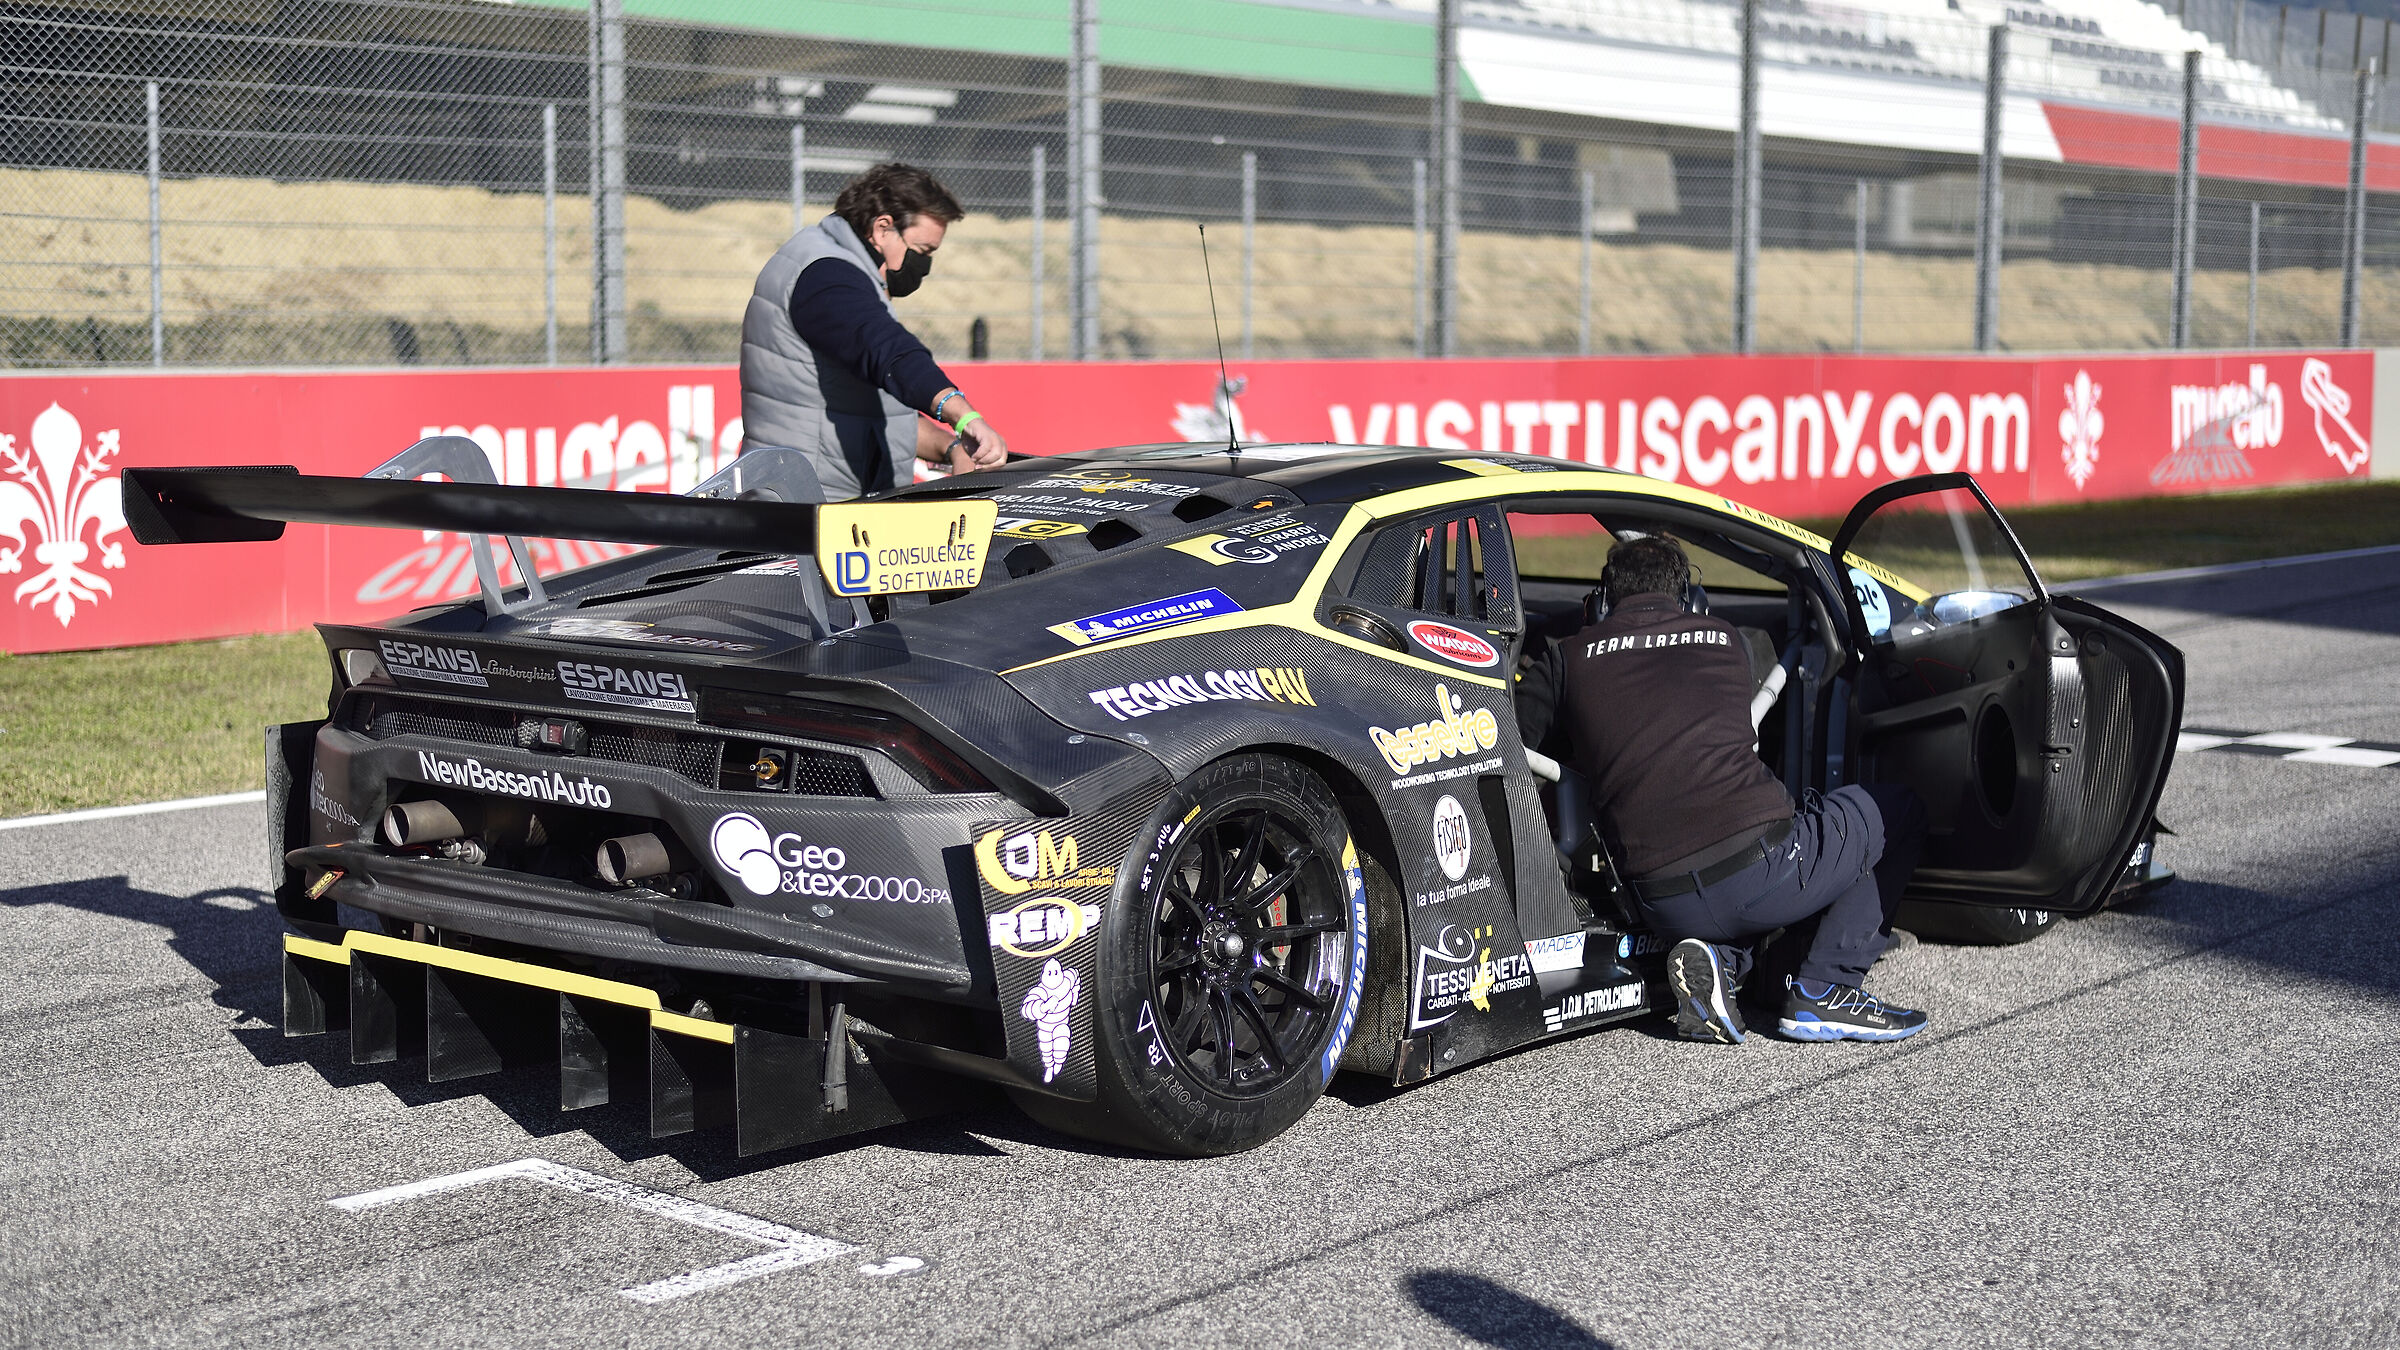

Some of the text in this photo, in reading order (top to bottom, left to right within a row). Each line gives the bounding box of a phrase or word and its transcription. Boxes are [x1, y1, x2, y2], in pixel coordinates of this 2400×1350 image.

[2171, 363, 2284, 454] mugello
[1258, 525, 1317, 544] GIRARDI
[1273, 533, 1332, 552] ANDREA
[878, 543, 976, 567] CONSULENZE
[879, 568, 976, 592] SOFTWARE
[1112, 599, 1215, 628] MICHELIN
[379, 640, 483, 674] ESPANSI
[1586, 630, 1728, 658] TEAM LAZARUS
[482, 660, 556, 682] Lamborghini
[557, 660, 689, 699] ESPANSI
[565, 688, 606, 701] LAVORAZIONE
[657, 700, 693, 711] MATERASSI
[418, 750, 612, 809] NewBassaniAuto
[1391, 757, 1503, 791] WOODWORKING TECHNOLOGY EVOLUTION
[772, 832, 847, 871] Geo
[1031, 880, 1054, 890] SCAVI
[1061, 878, 1085, 888] LAVORI
[1141, 864, 1153, 892] SET
[1150, 852, 1160, 862] 3
[1416, 874, 1491, 907] la tua forma ideale
[1328, 902, 1368, 1070] MICHELIN
[1427, 954, 1530, 996] TESSILVENETA
[1427, 994, 1457, 1010] CARDATI
[1492, 981, 1506, 994] NON
[1506, 975, 1530, 991] TESSUTI
[1159, 1073, 1209, 1118] SPORT
